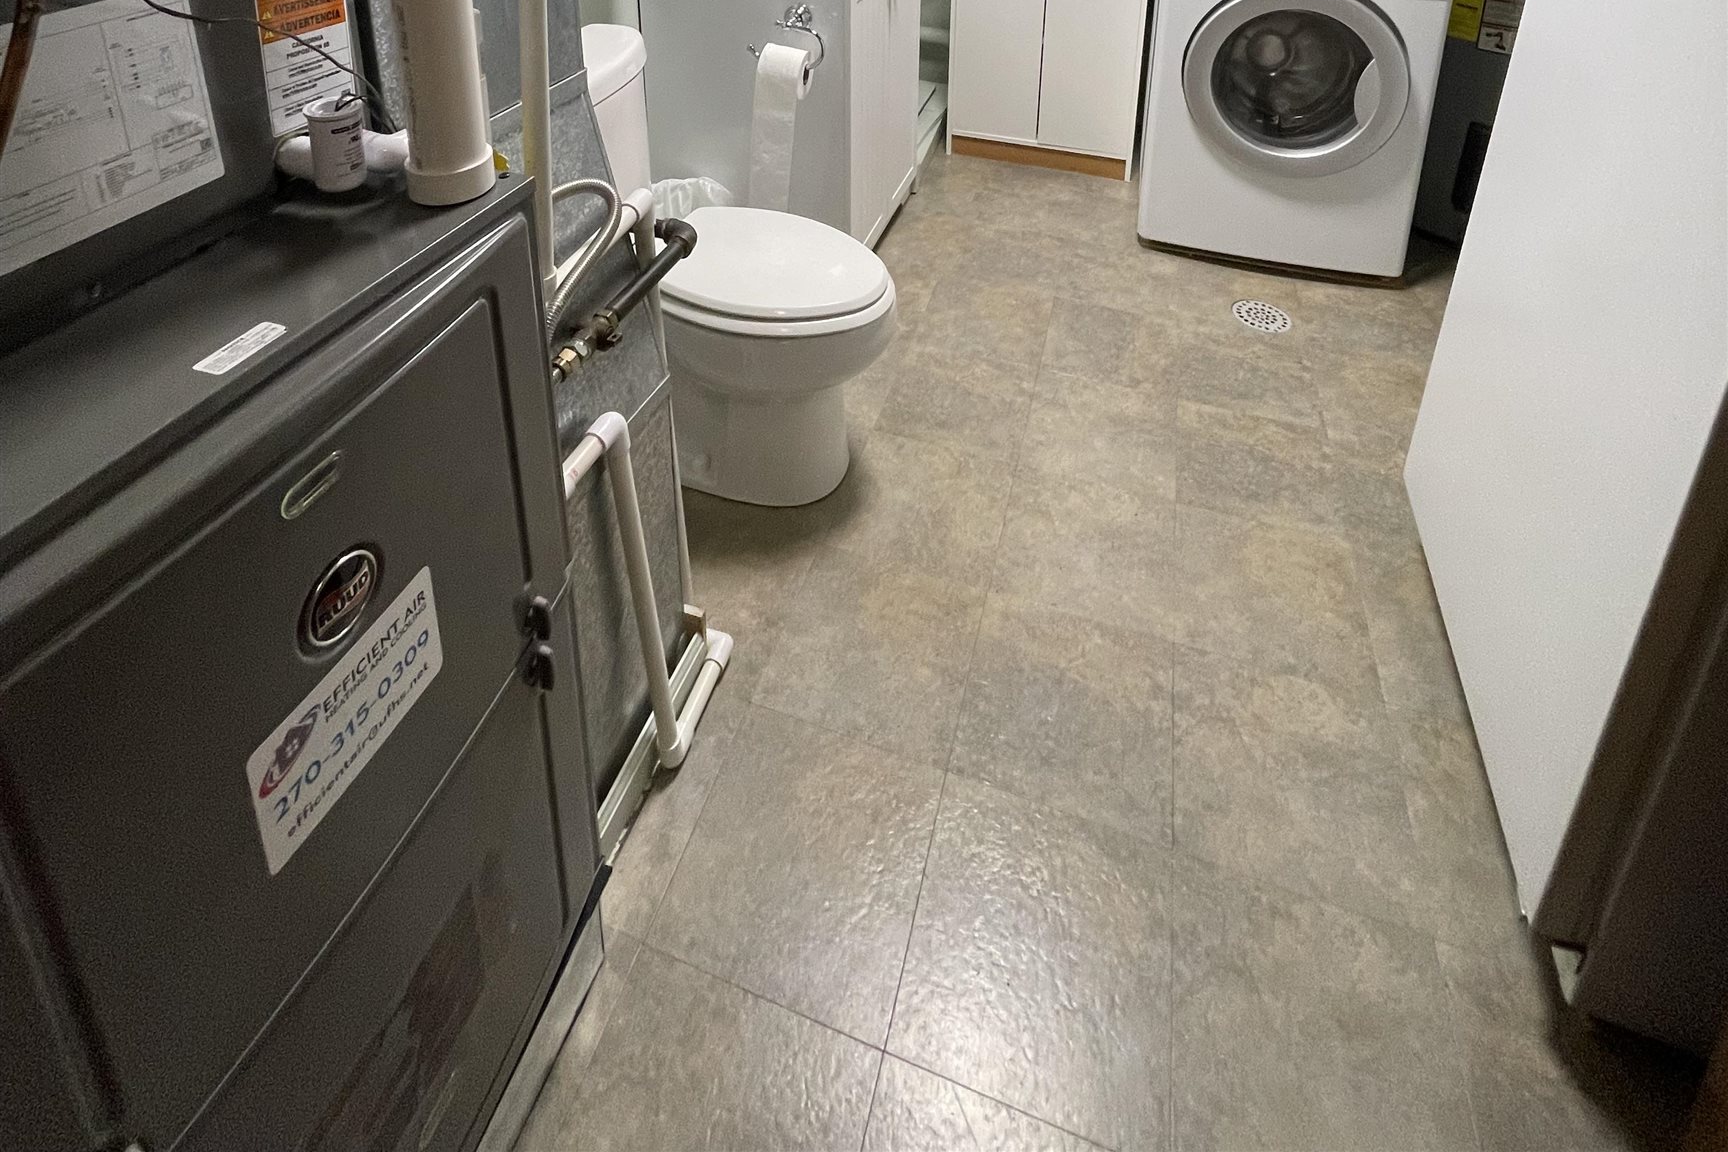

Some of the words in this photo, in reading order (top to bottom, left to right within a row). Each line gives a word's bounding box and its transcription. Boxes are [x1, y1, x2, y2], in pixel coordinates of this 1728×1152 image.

[279, 10, 341, 34] ADVERTENCIA
[317, 570, 370, 628] RUUD
[322, 617, 400, 713] EFFICIENT
[403, 590, 427, 622] AIR
[324, 674, 369, 723] HEATING
[369, 649, 389, 673] AND
[390, 602, 428, 648] COOLING
[273, 629, 430, 824] 270-315-0309
